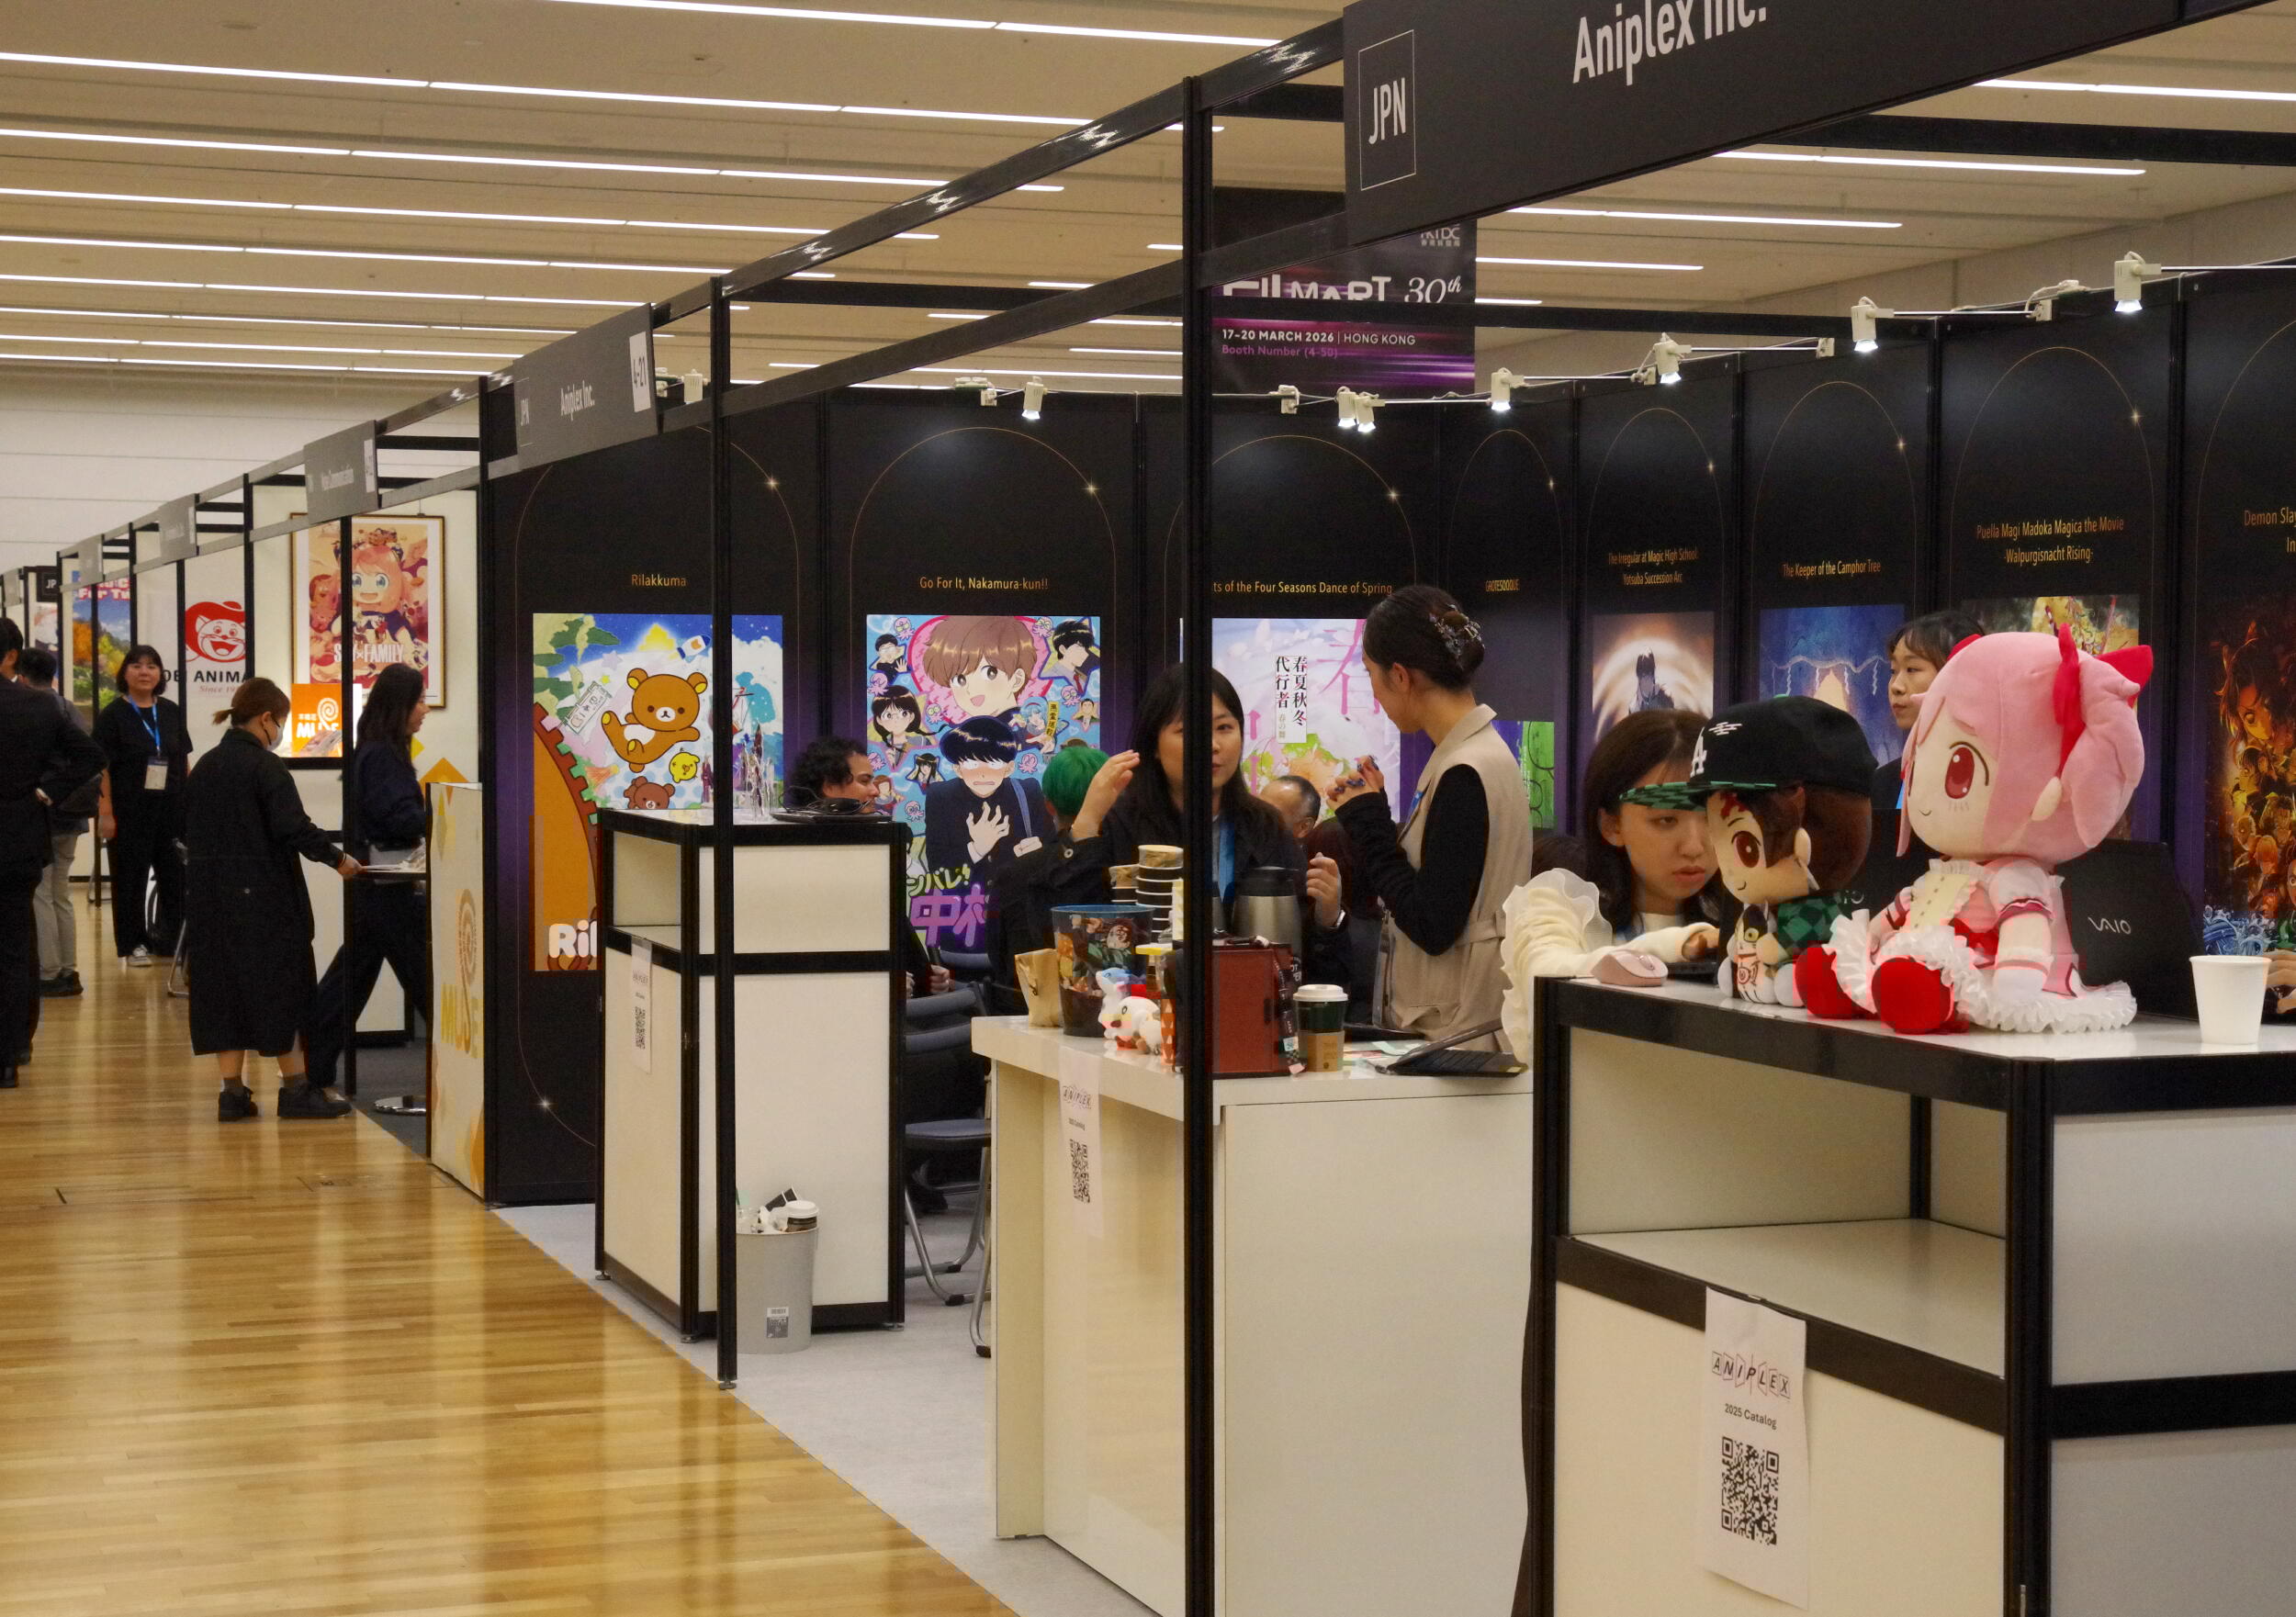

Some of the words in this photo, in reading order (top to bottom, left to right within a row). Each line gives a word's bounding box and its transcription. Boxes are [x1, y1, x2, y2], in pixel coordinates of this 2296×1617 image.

[1573, 0, 1694, 86] Aniplex
[1704, 0, 1767, 39] Inc.
[1368, 77, 1407, 145] JPN
[1222, 329, 1255, 340] 17-20
[1259, 331, 1302, 342] MARCH
[1305, 331, 1334, 342] 2026
[1344, 332, 1379, 344] HONG
[1381, 333, 1416, 345] KONG
[1222, 344, 1255, 355] Booth
[1258, 345, 1300, 357] Number
[2244, 510, 2278, 526] Demon
[1976, 522, 1999, 540] Puella
[2001, 522, 2020, 541] Magi
[2022, 519, 2053, 537] Madoka
[2054, 518, 2082, 538] Magica
[2084, 516, 2097, 533] the
[2099, 516, 2124, 532] Movie
[1648, 550, 1663, 566] Magic
[1664, 548, 1678, 565] High
[1644, 571, 1672, 584] Succession
[1783, 563, 1794, 578] The
[1795, 562, 1818, 579] Keeper
[1818, 560, 1825, 575] of
[1826, 560, 1836, 575] the
[1838, 559, 1866, 577] Camphor
[1867, 558, 1881, 572] Tree
[631, 573, 687, 587] Rilakkuma
[919, 577, 933, 589] Go
[937, 577, 952, 589] For
[955, 577, 964, 590] It,
[968, 577, 1049, 590] Nakamura-kun!!
[1225, 580, 1234, 592] of
[1236, 580, 1252, 592] the
[1255, 580, 1276, 593] Four
[1278, 580, 1317, 593] Seasons
[1319, 581, 1347, 593] Dance
[1350, 581, 1360, 594] of
[1362, 581, 1392, 597] Spring
[1276, 656, 1289, 709] 代行者
[1292, 656, 1308, 726] 春夏秋冬
[2088, 916, 2131, 934] VAIO
[1713, 1353, 1789, 1398] ANIPLEX
[1725, 1403, 1742, 1418] 2025
[1744, 1409, 1777, 1430] Catalog
